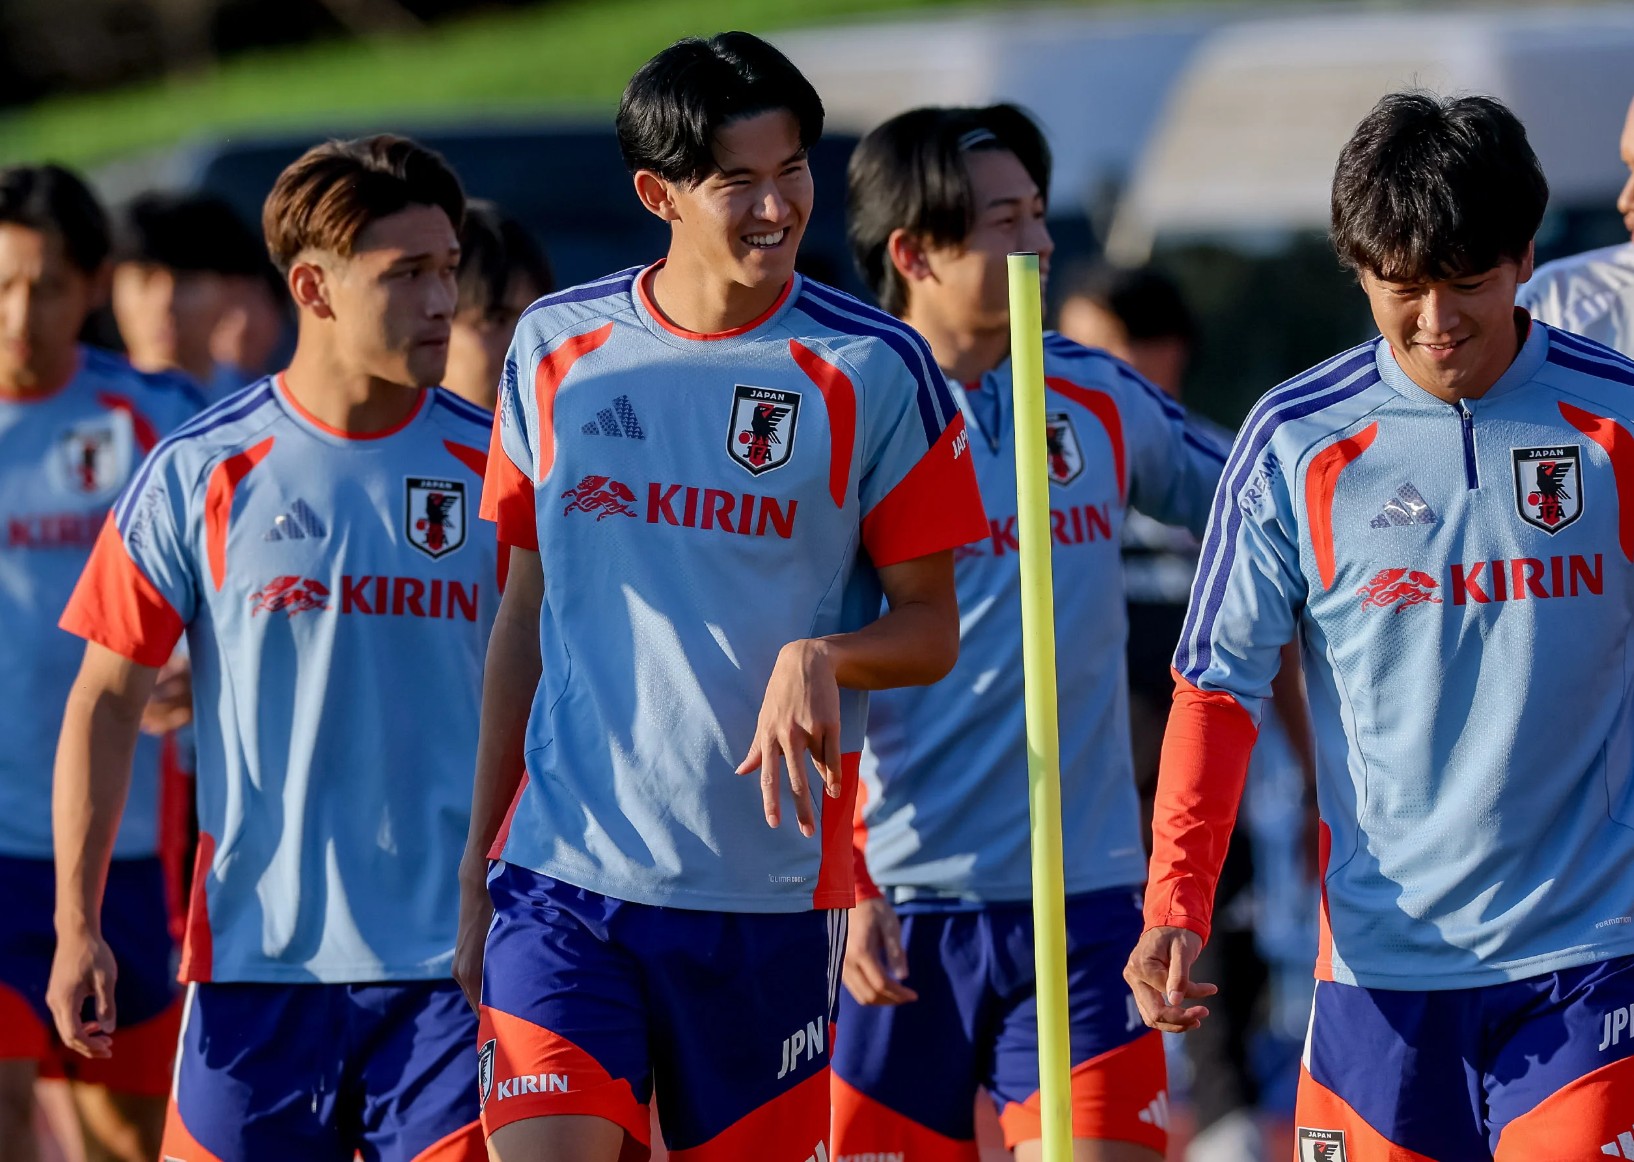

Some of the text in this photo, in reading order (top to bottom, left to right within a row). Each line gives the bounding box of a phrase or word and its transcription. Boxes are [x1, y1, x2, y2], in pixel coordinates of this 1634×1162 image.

[750, 390, 785, 401] JAPAN
[742, 445, 773, 461] JFA
[1529, 449, 1564, 458] JAPAN
[421, 480, 453, 489] JAPAN
[647, 482, 798, 539] KIRIN
[1536, 505, 1566, 519] JFA
[989, 502, 1112, 557] KRIN
[1450, 553, 1603, 606] KIRIN
[341, 575, 478, 622] KIRIN
[1598, 1003, 1634, 1052] JP
[777, 1015, 824, 1080] JPN
[497, 1073, 568, 1102] KIRIN
[1308, 1131, 1332, 1139] JAPAN
